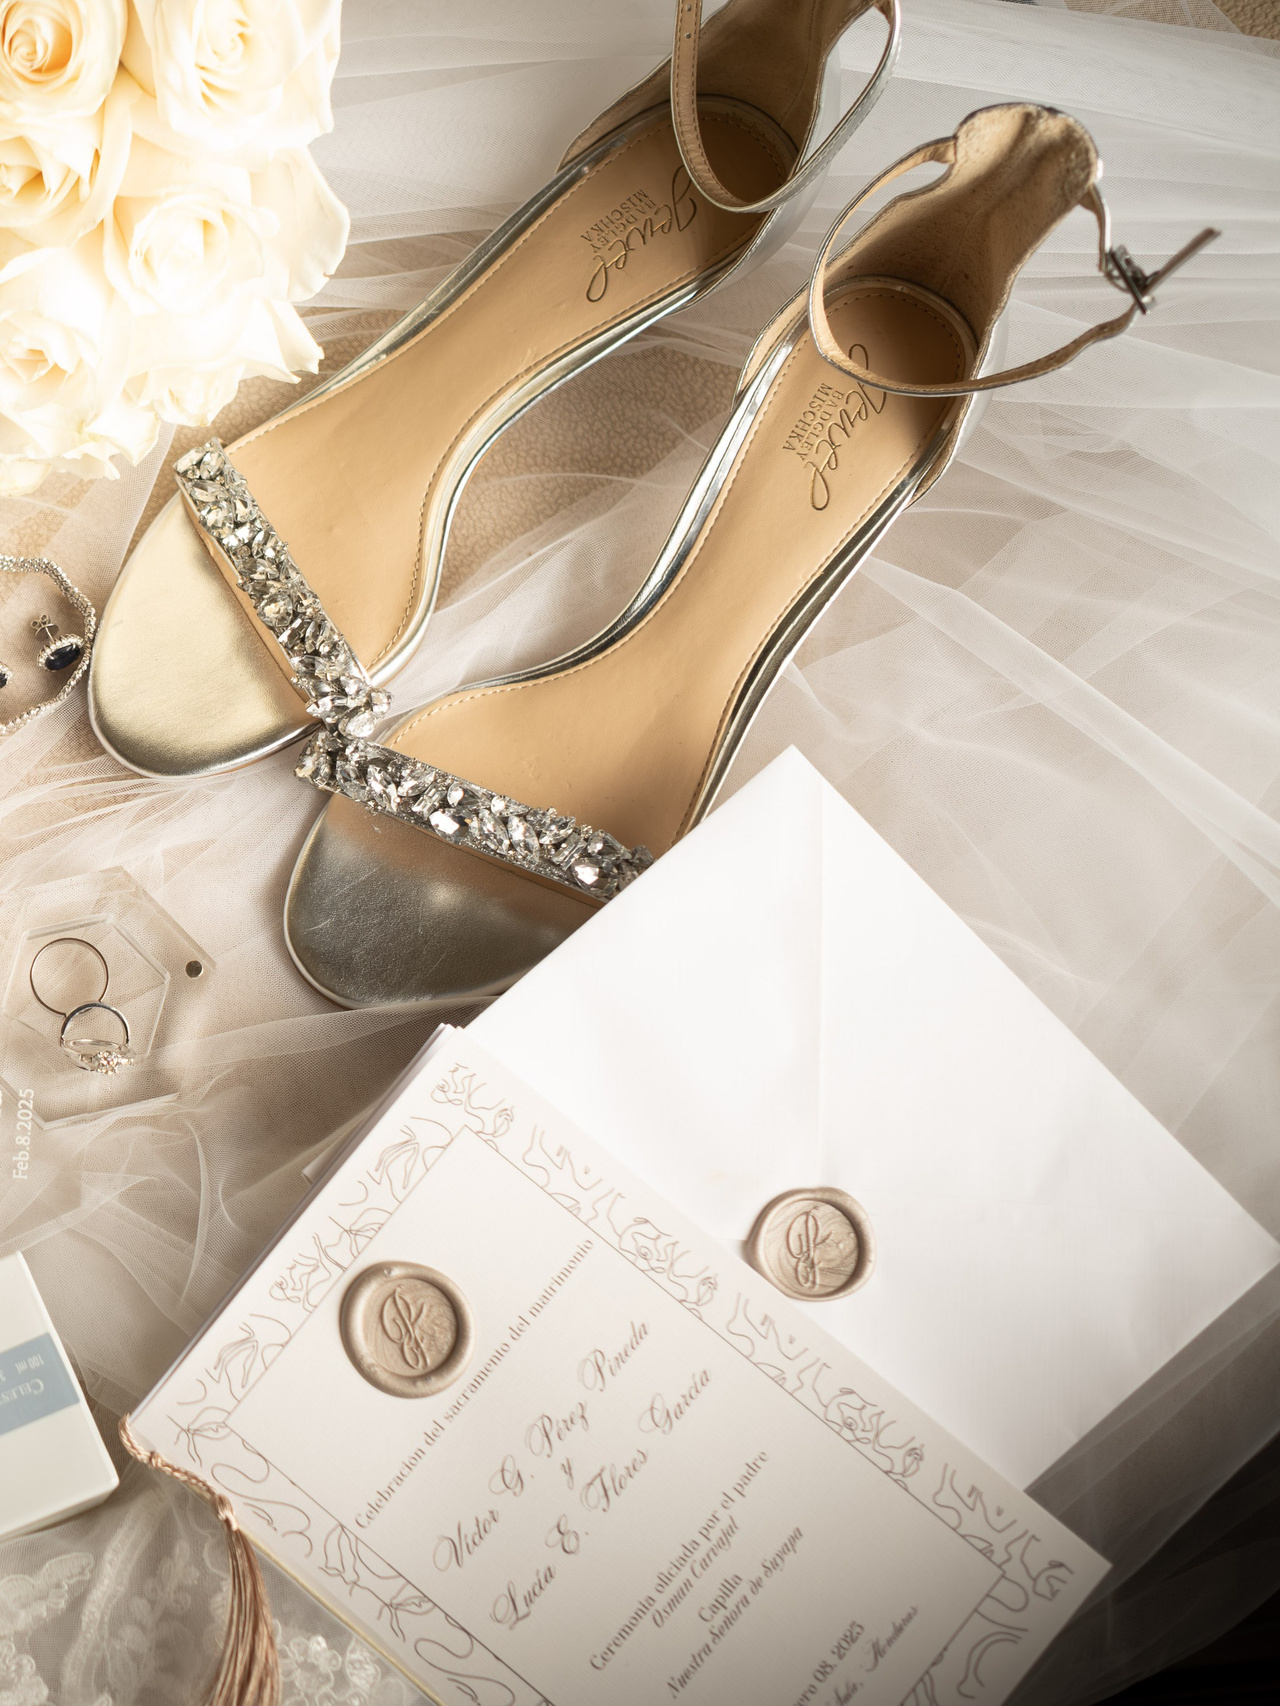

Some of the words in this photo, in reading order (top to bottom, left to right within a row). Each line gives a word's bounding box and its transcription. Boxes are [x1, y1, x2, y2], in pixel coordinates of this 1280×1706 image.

[580, 188, 649, 242] MISCHKA
[590, 197, 657, 254] BADGLEY
[782, 382, 833, 453] MISCHKA
[797, 390, 845, 460] BADGLEY
[12, 1088, 35, 1180] Feb.8.2025
[14, 1361, 27, 1376] ml
[27, 1353, 45, 1371] 100
[423, 1419, 444, 1446] del
[444, 1342, 509, 1421] sacramento
[508, 1315, 530, 1340] del
[528, 1239, 592, 1317] matrimonio
[578, 1320, 651, 1392] Pineda
[559, 1456, 576, 1491] y
[580, 1446, 650, 1513] Flores
[589, 1595, 655, 1670] Ceremonia
[654, 1539, 700, 1593] oficiada
[697, 1510, 720, 1540] por
[720, 1491, 735, 1509] el
[732, 1451, 766, 1496] padre
[651, 1578, 693, 1627] Osman
[689, 1515, 738, 1578] Carvajal
[667, 1643, 712, 1699] Nuestra
[748, 1576, 763, 1595] de
[761, 1527, 803, 1578] Suyapa
[697, 1571, 743, 1624] Capilla
[830, 1620, 865, 1660] 2025
